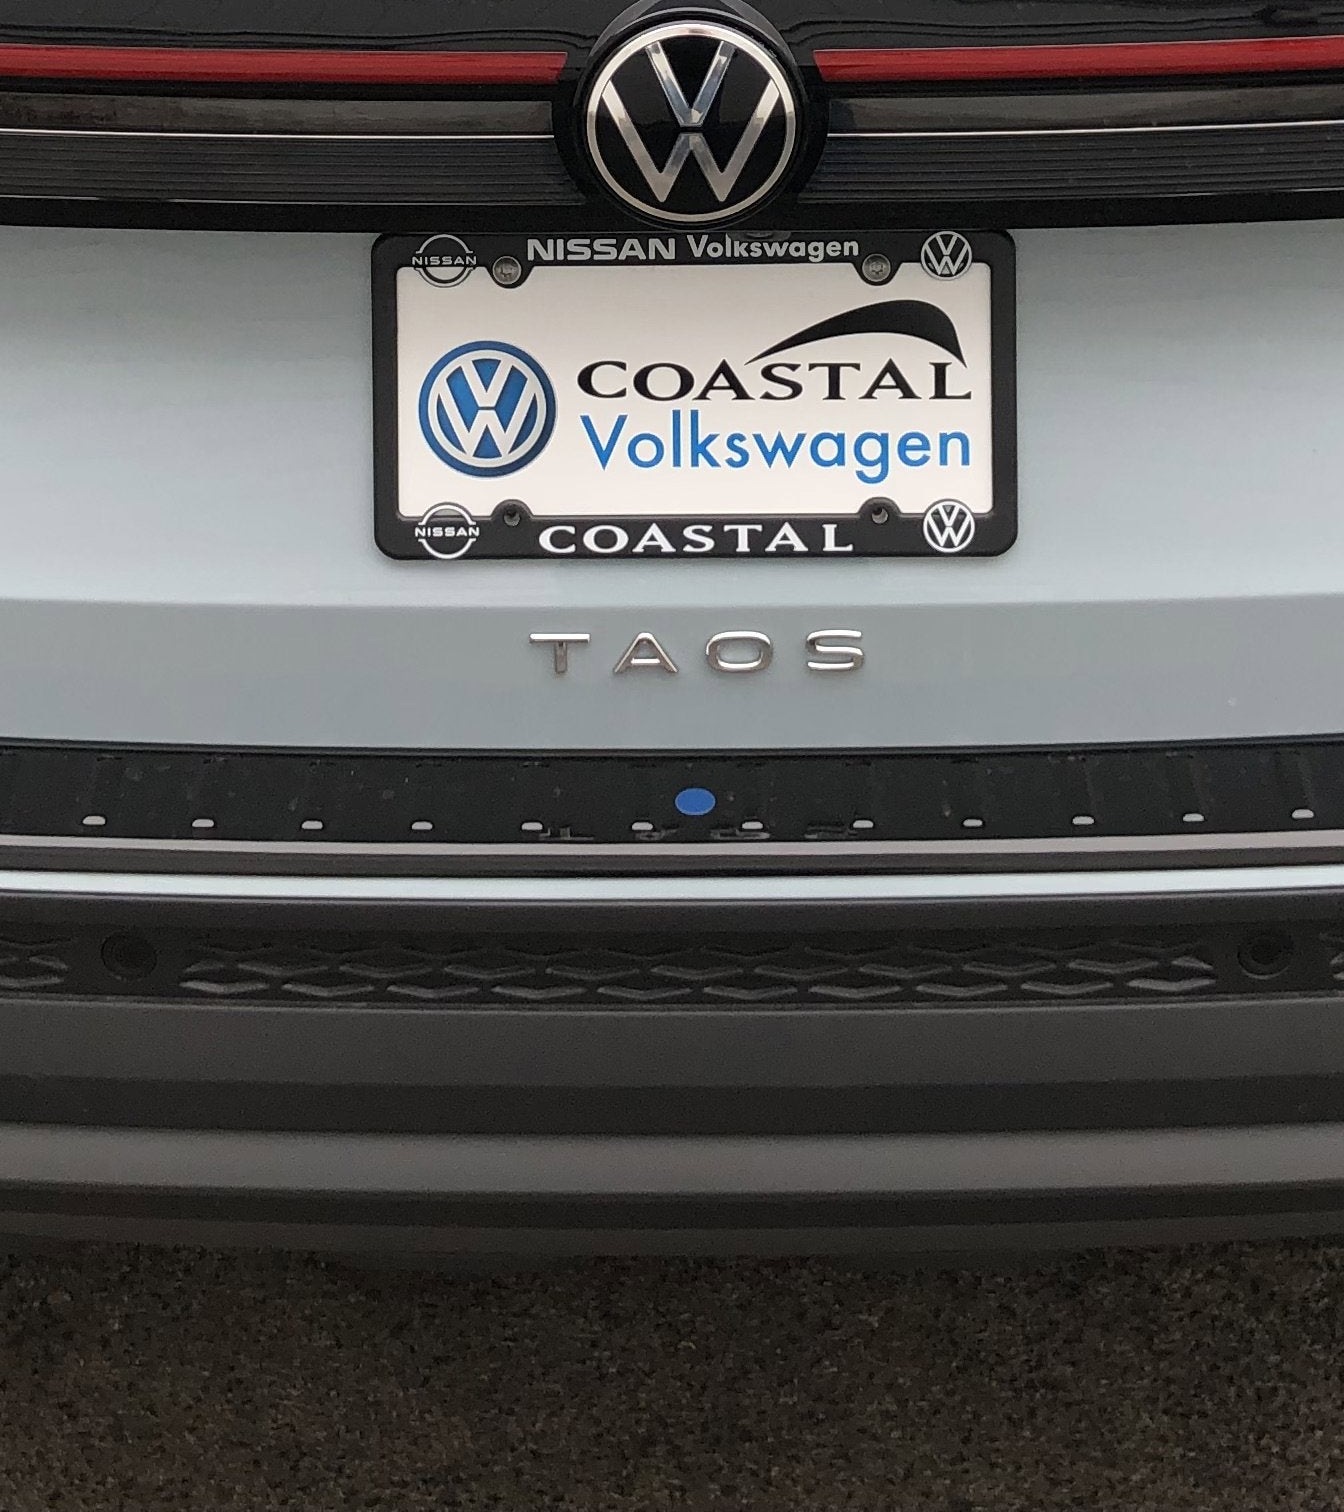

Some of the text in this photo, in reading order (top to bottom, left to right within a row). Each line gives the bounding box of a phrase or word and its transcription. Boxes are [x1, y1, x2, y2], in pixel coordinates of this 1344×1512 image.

[412, 255, 478, 266] NISSAN
[527, 233, 859, 263] NISSAN Volkswagen
[576, 359, 972, 401] COASTAL
[580, 408, 971, 484] Volkswagen
[414, 526, 480, 538] NISSAN
[538, 521, 854, 554] COASTAL
[528, 628, 866, 675] TAOS
